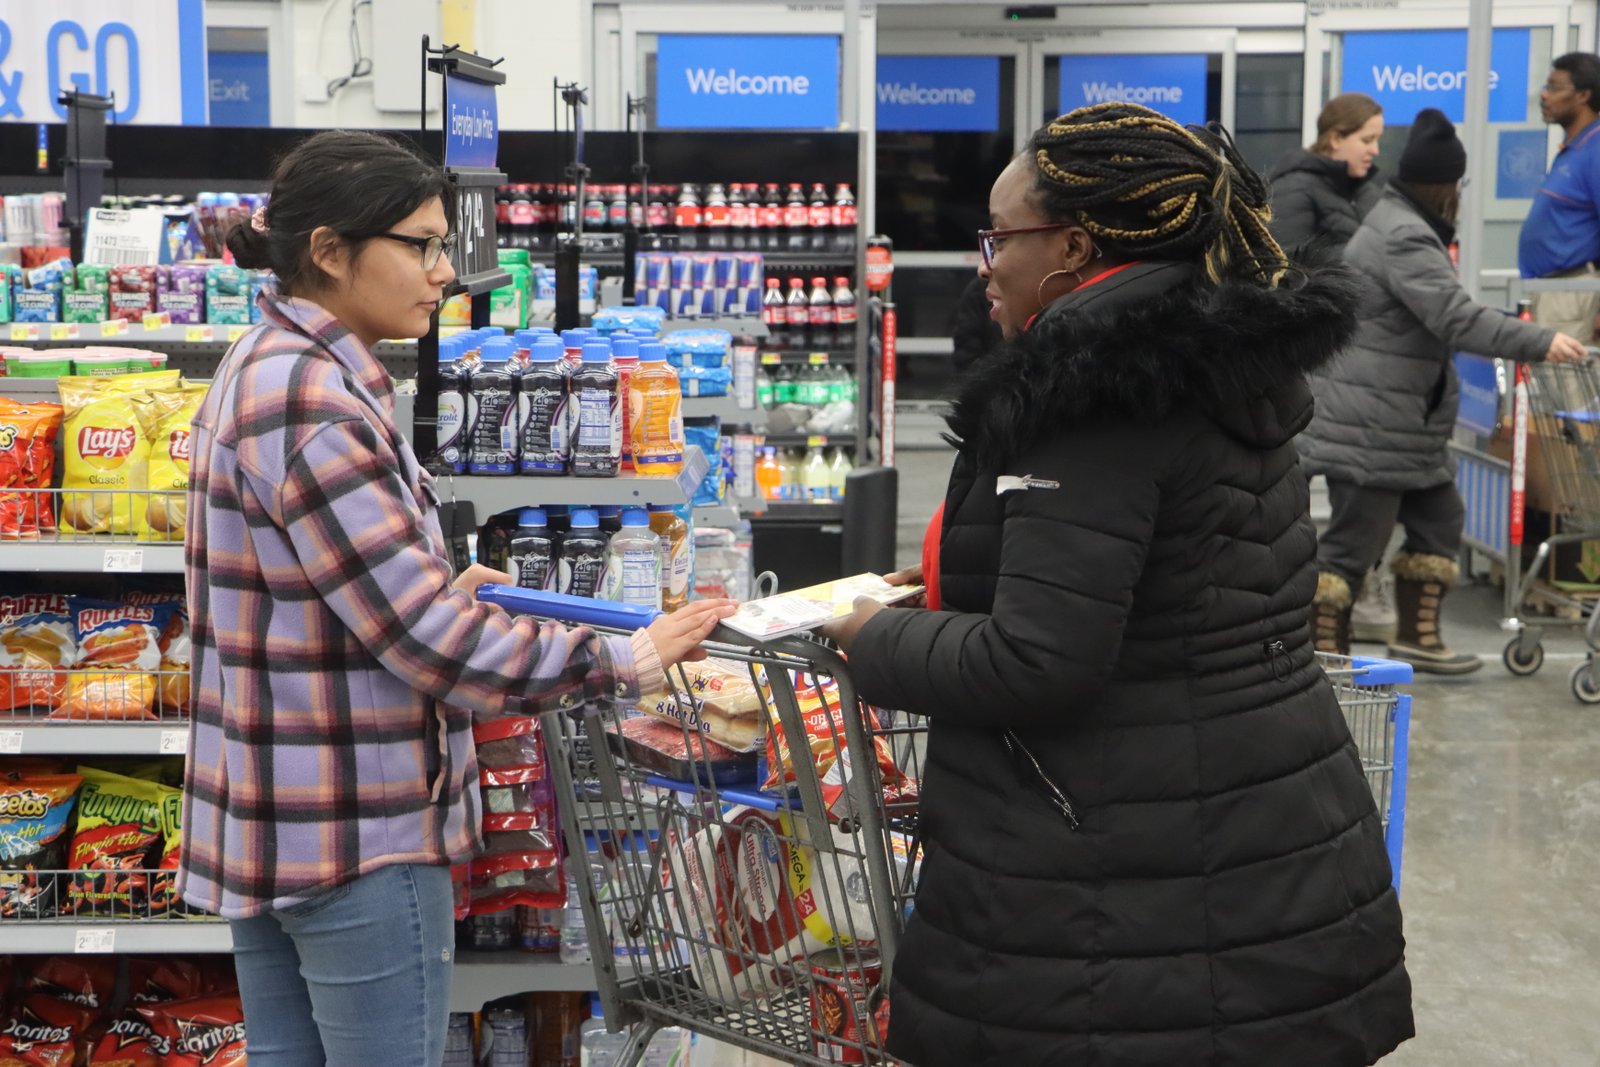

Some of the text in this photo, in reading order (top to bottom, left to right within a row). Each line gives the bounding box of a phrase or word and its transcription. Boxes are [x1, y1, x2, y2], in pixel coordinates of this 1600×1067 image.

[47, 19, 139, 123] GO
[686, 67, 810, 97] Welcome
[209, 80, 250, 101] Exit
[877, 82, 976, 106] Welcome
[1082, 80, 1183, 104] Welcome
[452, 104, 494, 146] Everyday Low Price
[81, 427, 134, 458] Lay's
[89, 475, 125, 485] Classic
[79, 606, 154, 633] RUFFLES
[656, 701, 665, 713] 8
[688, 712, 711, 733] Dg
[17, 823, 45, 840] Hot
[117, 831, 147, 847] Hot
[746, 833, 757, 868] Ultra
[799, 892, 813, 915] 24
[3, 1018, 73, 1042] Doritos
[106, 1019, 171, 1054] Doritos
[177, 1022, 246, 1054] Doritos
